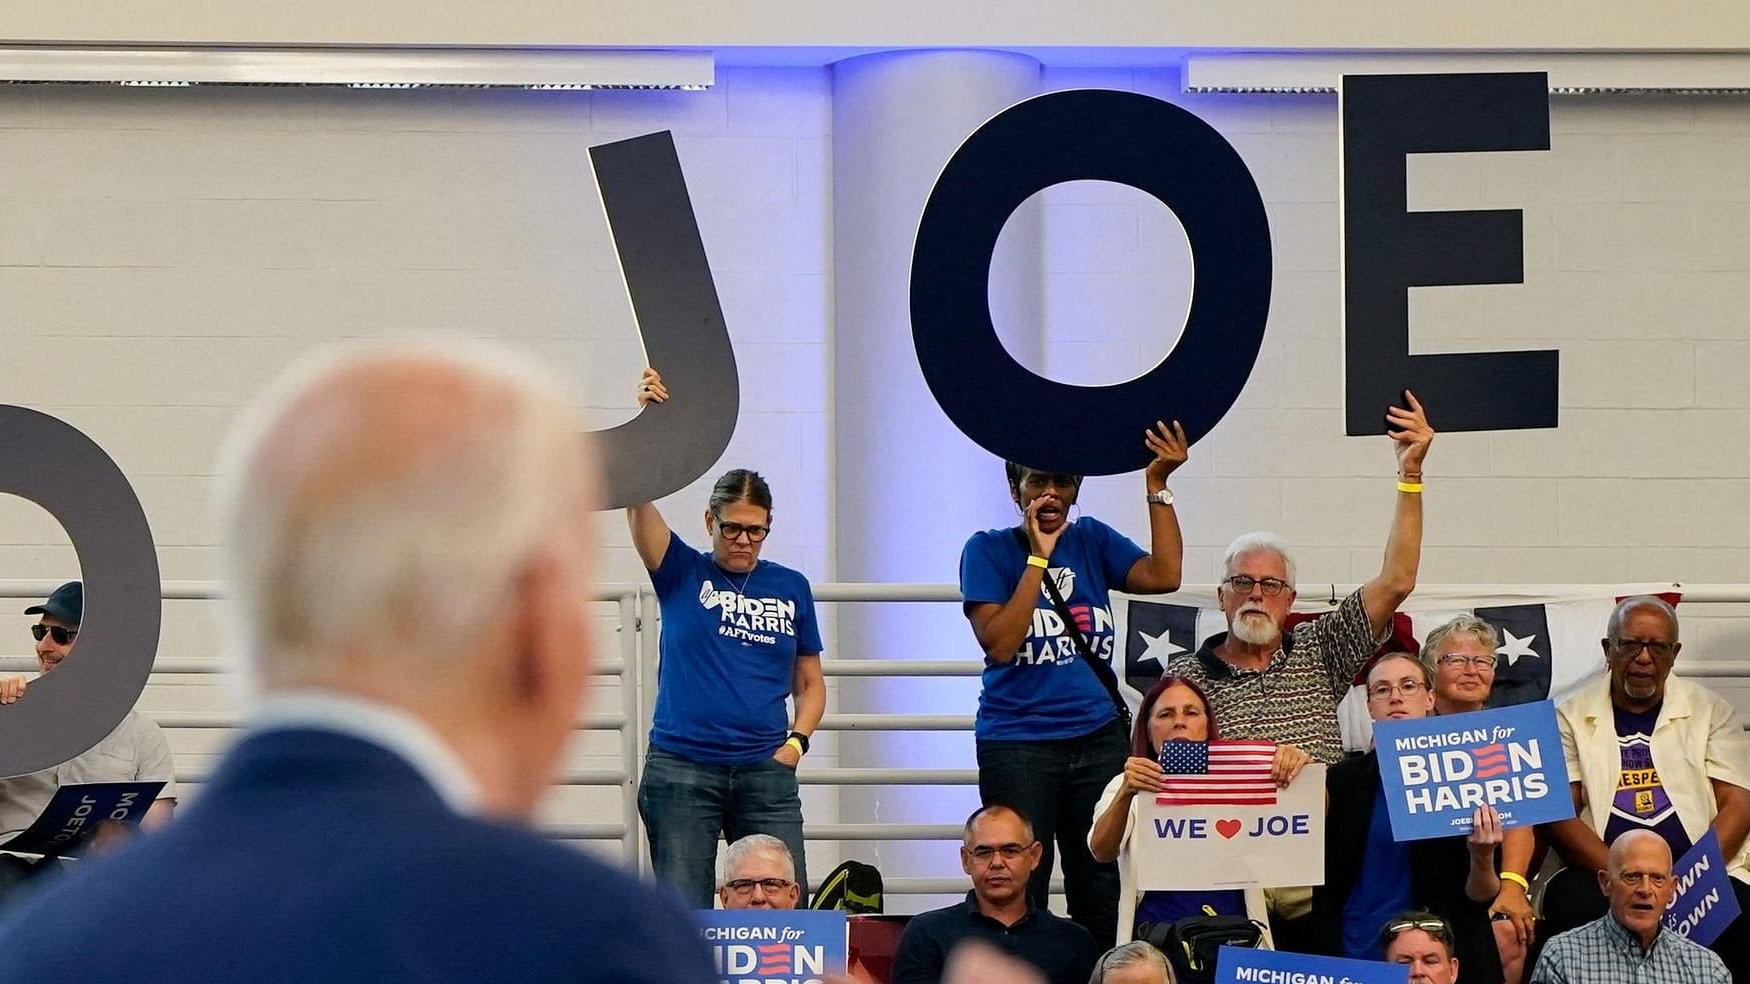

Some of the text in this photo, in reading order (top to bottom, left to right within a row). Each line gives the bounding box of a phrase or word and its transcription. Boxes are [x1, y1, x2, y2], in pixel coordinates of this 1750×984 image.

[1026, 604, 1114, 638] IDEN
[1395, 726, 1515, 751] MICHIGAN for
[1399, 739, 1543, 786] BIDEN
[1405, 773, 1549, 814] HARRIS
[1618, 771, 1659, 788] ESPE
[1154, 815, 1309, 839] WE JOE
[701, 926, 805, 943] CHIGAN for
[714, 943, 824, 976] IDEN
